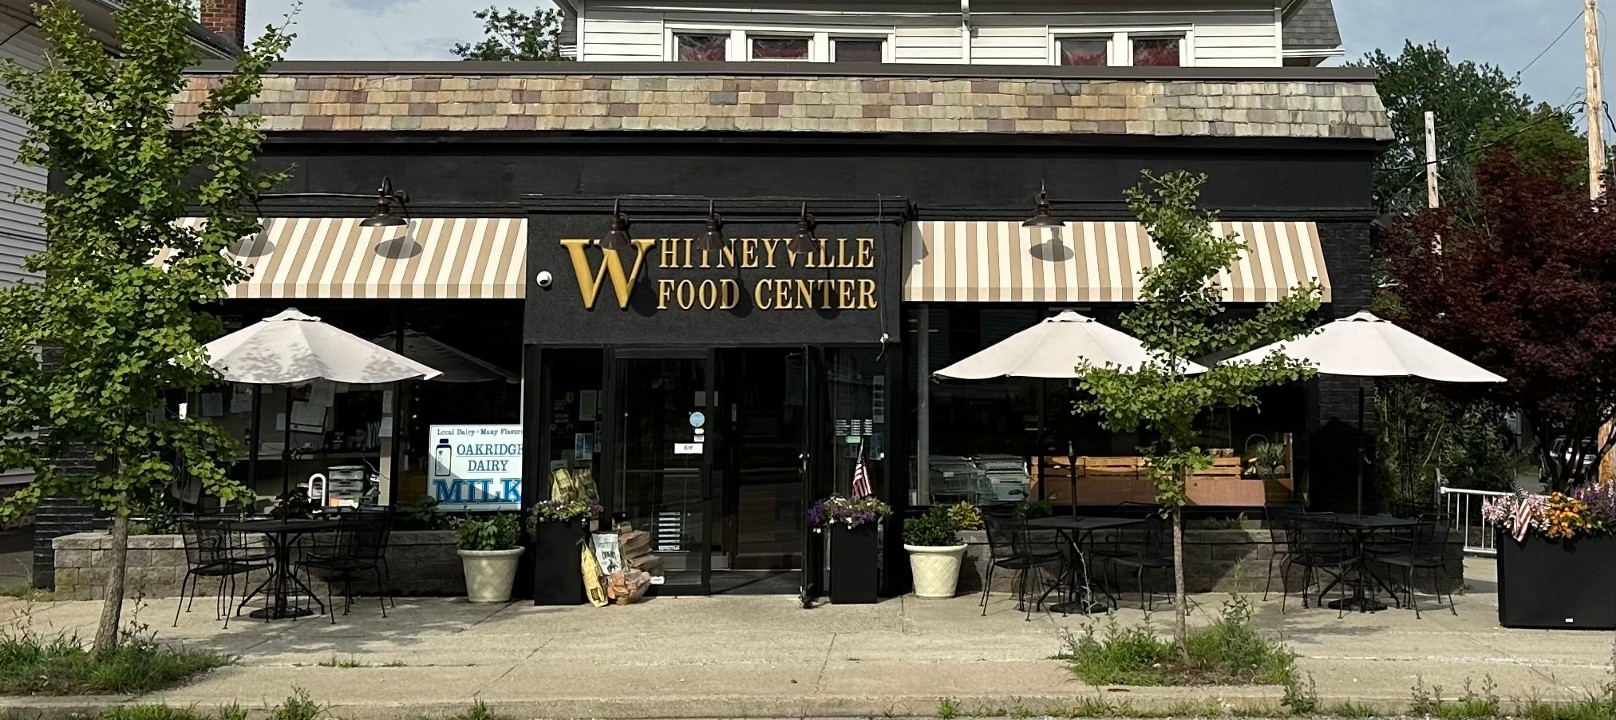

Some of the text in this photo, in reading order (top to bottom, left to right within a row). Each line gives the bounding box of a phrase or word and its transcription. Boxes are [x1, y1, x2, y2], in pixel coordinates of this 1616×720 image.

[656, 278, 878, 310] FOOD CENTER
[468, 460, 509, 471] DAIRY
[433, 478, 522, 503] MILK
